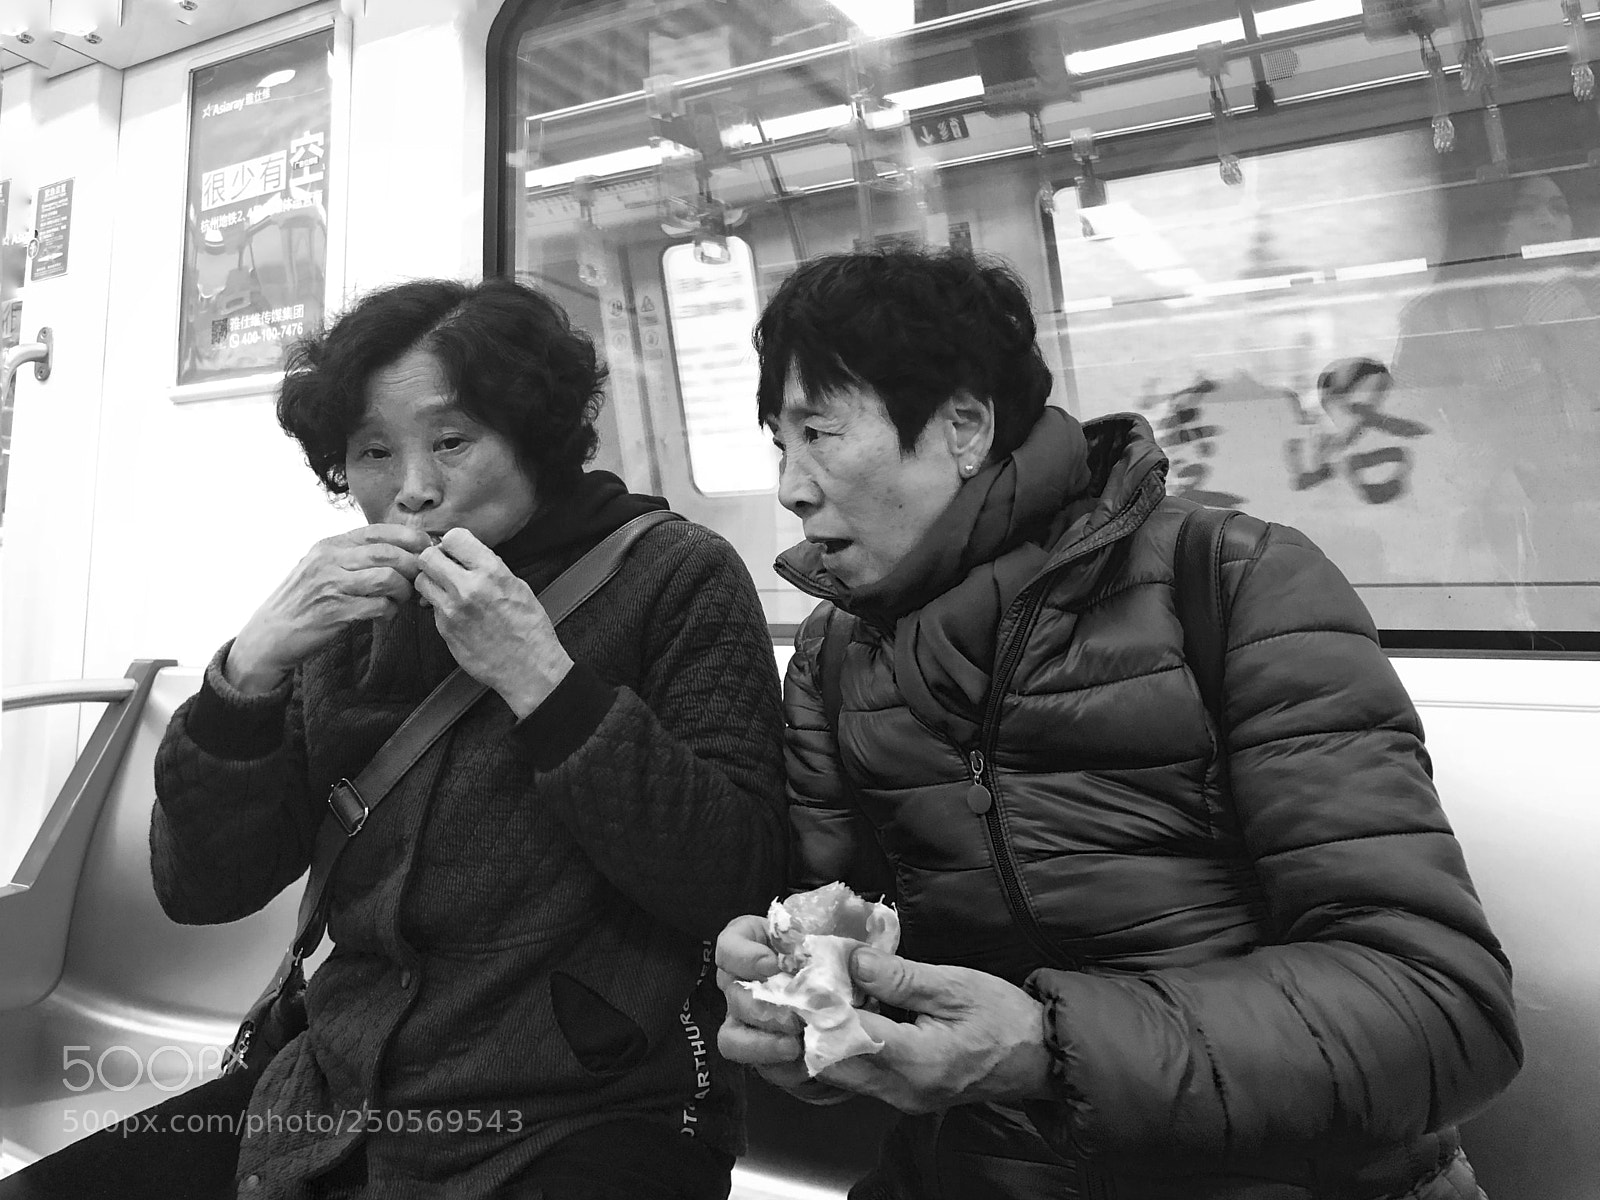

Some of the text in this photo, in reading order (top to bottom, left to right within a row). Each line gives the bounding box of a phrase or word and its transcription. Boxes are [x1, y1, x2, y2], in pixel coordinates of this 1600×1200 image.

[212, 98, 245, 116] Asiaray
[230, 304, 304, 332] 雅仕维传媒集团
[242, 322, 304, 345] 400-100-7476
